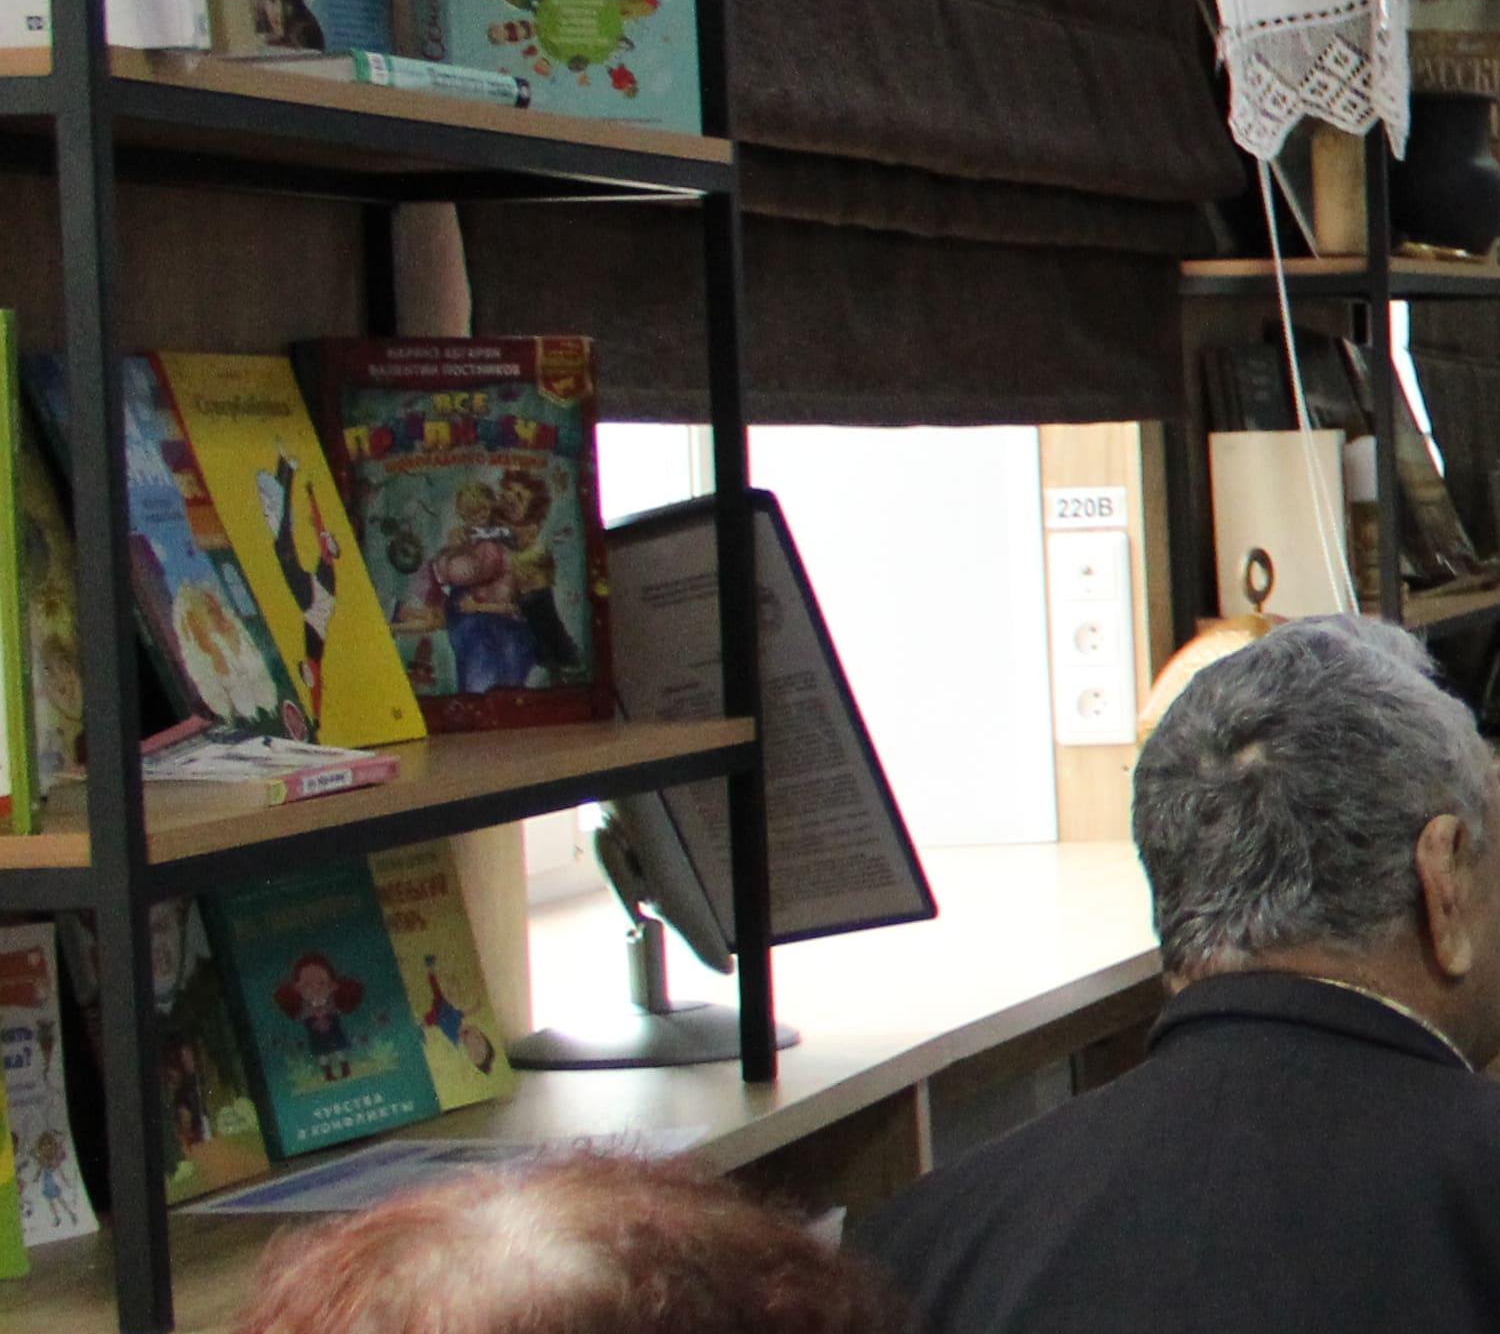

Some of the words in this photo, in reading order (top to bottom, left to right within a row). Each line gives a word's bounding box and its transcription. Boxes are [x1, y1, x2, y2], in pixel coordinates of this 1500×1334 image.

[433, 392, 488, 413] ВСЕ
[1056, 497, 1114, 519] 220В
[310, 1100, 414, 1136] КОНФЛИКТЫ
[312, 1092, 384, 1120] ЧУВСТВА
